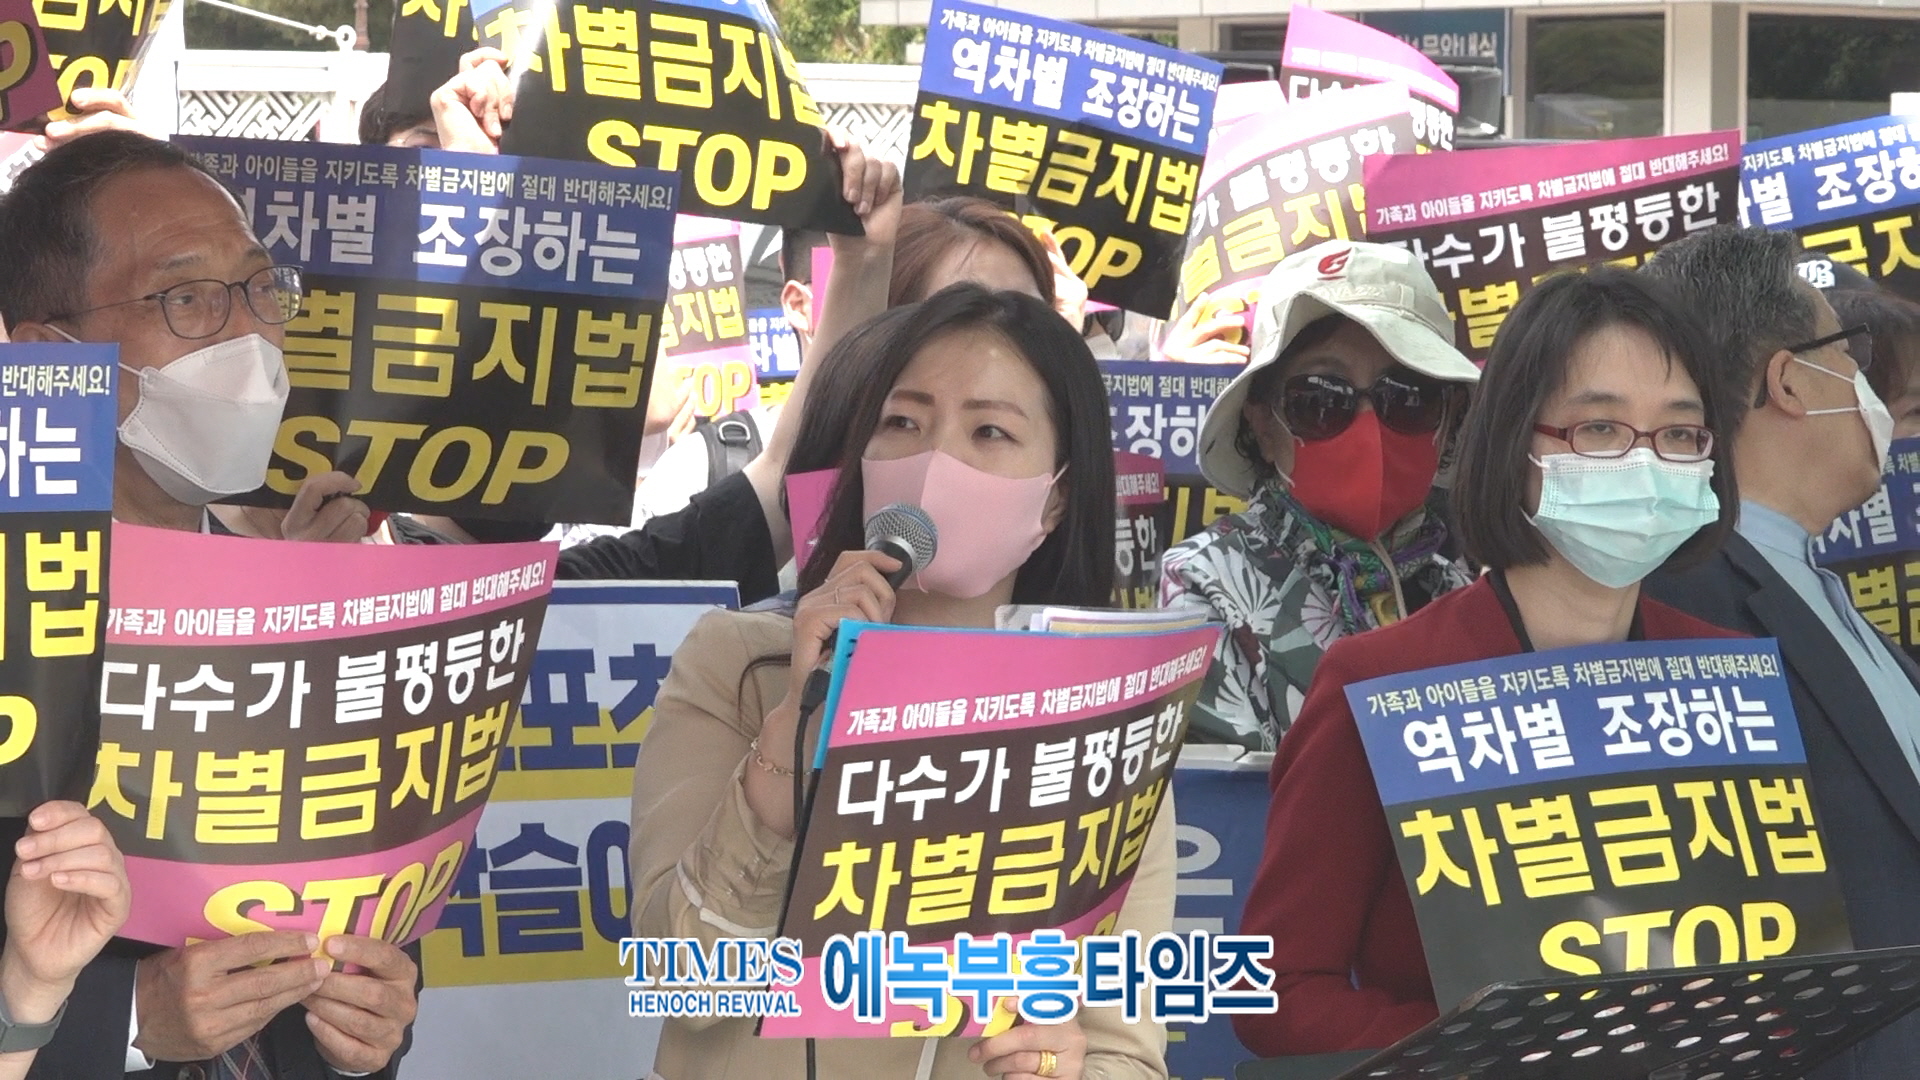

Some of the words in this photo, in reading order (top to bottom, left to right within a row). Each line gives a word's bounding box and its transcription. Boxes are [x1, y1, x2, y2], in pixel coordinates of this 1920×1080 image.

[952, 37, 1069, 110] 역차별
[1082, 67, 1200, 144] 조장하는
[245, 155, 319, 183] 아이들을
[325, 160, 399, 188] 지키도록
[405, 163, 515, 199] 차별금지법에
[521, 173, 557, 202] 절대
[563, 177, 673, 211] 반대해주세요!
[587, 119, 807, 211] STOP
[912, 100, 1199, 236] 차별금지법
[1376, 205, 1417, 226] 가족과
[1421, 194, 1475, 220] 아이들을
[1479, 184, 1533, 210] 지키도록
[1537, 167, 1617, 200] 차별금지법에
[1619, 161, 1645, 183] 절대
[1649, 143, 1730, 177] 반대해주세요!
[412, 203, 641, 285] 조장하는
[1542, 181, 1720, 263] 불평등한
[2, 365, 110, 397] 반대해주세요!
[1158, 375, 1185, 398] 절대
[264, 416, 571, 505] STOP
[106, 607, 165, 637] 가족과
[174, 606, 255, 638] 아이들을
[262, 601, 335, 634] 지키도록
[341, 586, 435, 628] 차별금지법에
[439, 580, 468, 611] 절대
[471, 559, 547, 606] 반대해주세요!
[101, 658, 311, 733] 다수가
[335, 616, 526, 725] 불평등한
[846, 705, 897, 736] 가족과
[902, 700, 967, 731] 아이들을
[972, 692, 1036, 724] 지키도록
[1040, 682, 1121, 716] 차별금지법에
[1124, 672, 1147, 697] 절대
[1149, 646, 1208, 693] 반대해주세요!
[1367, 687, 1423, 718] 가족과
[1425, 676, 1497, 708] 아이들을
[1500, 664, 1570, 696] 지키도록
[1573, 655, 1664, 686] 차별금지법에
[1666, 655, 1695, 678] 절대
[1697, 653, 1780, 681] 반대해주세요!
[87, 700, 509, 844] 차별금지법
[837, 747, 1010, 825] 다수가
[1029, 699, 1184, 808] 불평등한
[1403, 698, 1575, 783] 역차별
[1597, 685, 1779, 758] 조장하는
[813, 778, 1164, 931] 차별금지법
[1400, 777, 1827, 906] 차별금지법
[186, 840, 464, 969] STOP
[1539, 901, 1797, 978] STOP
